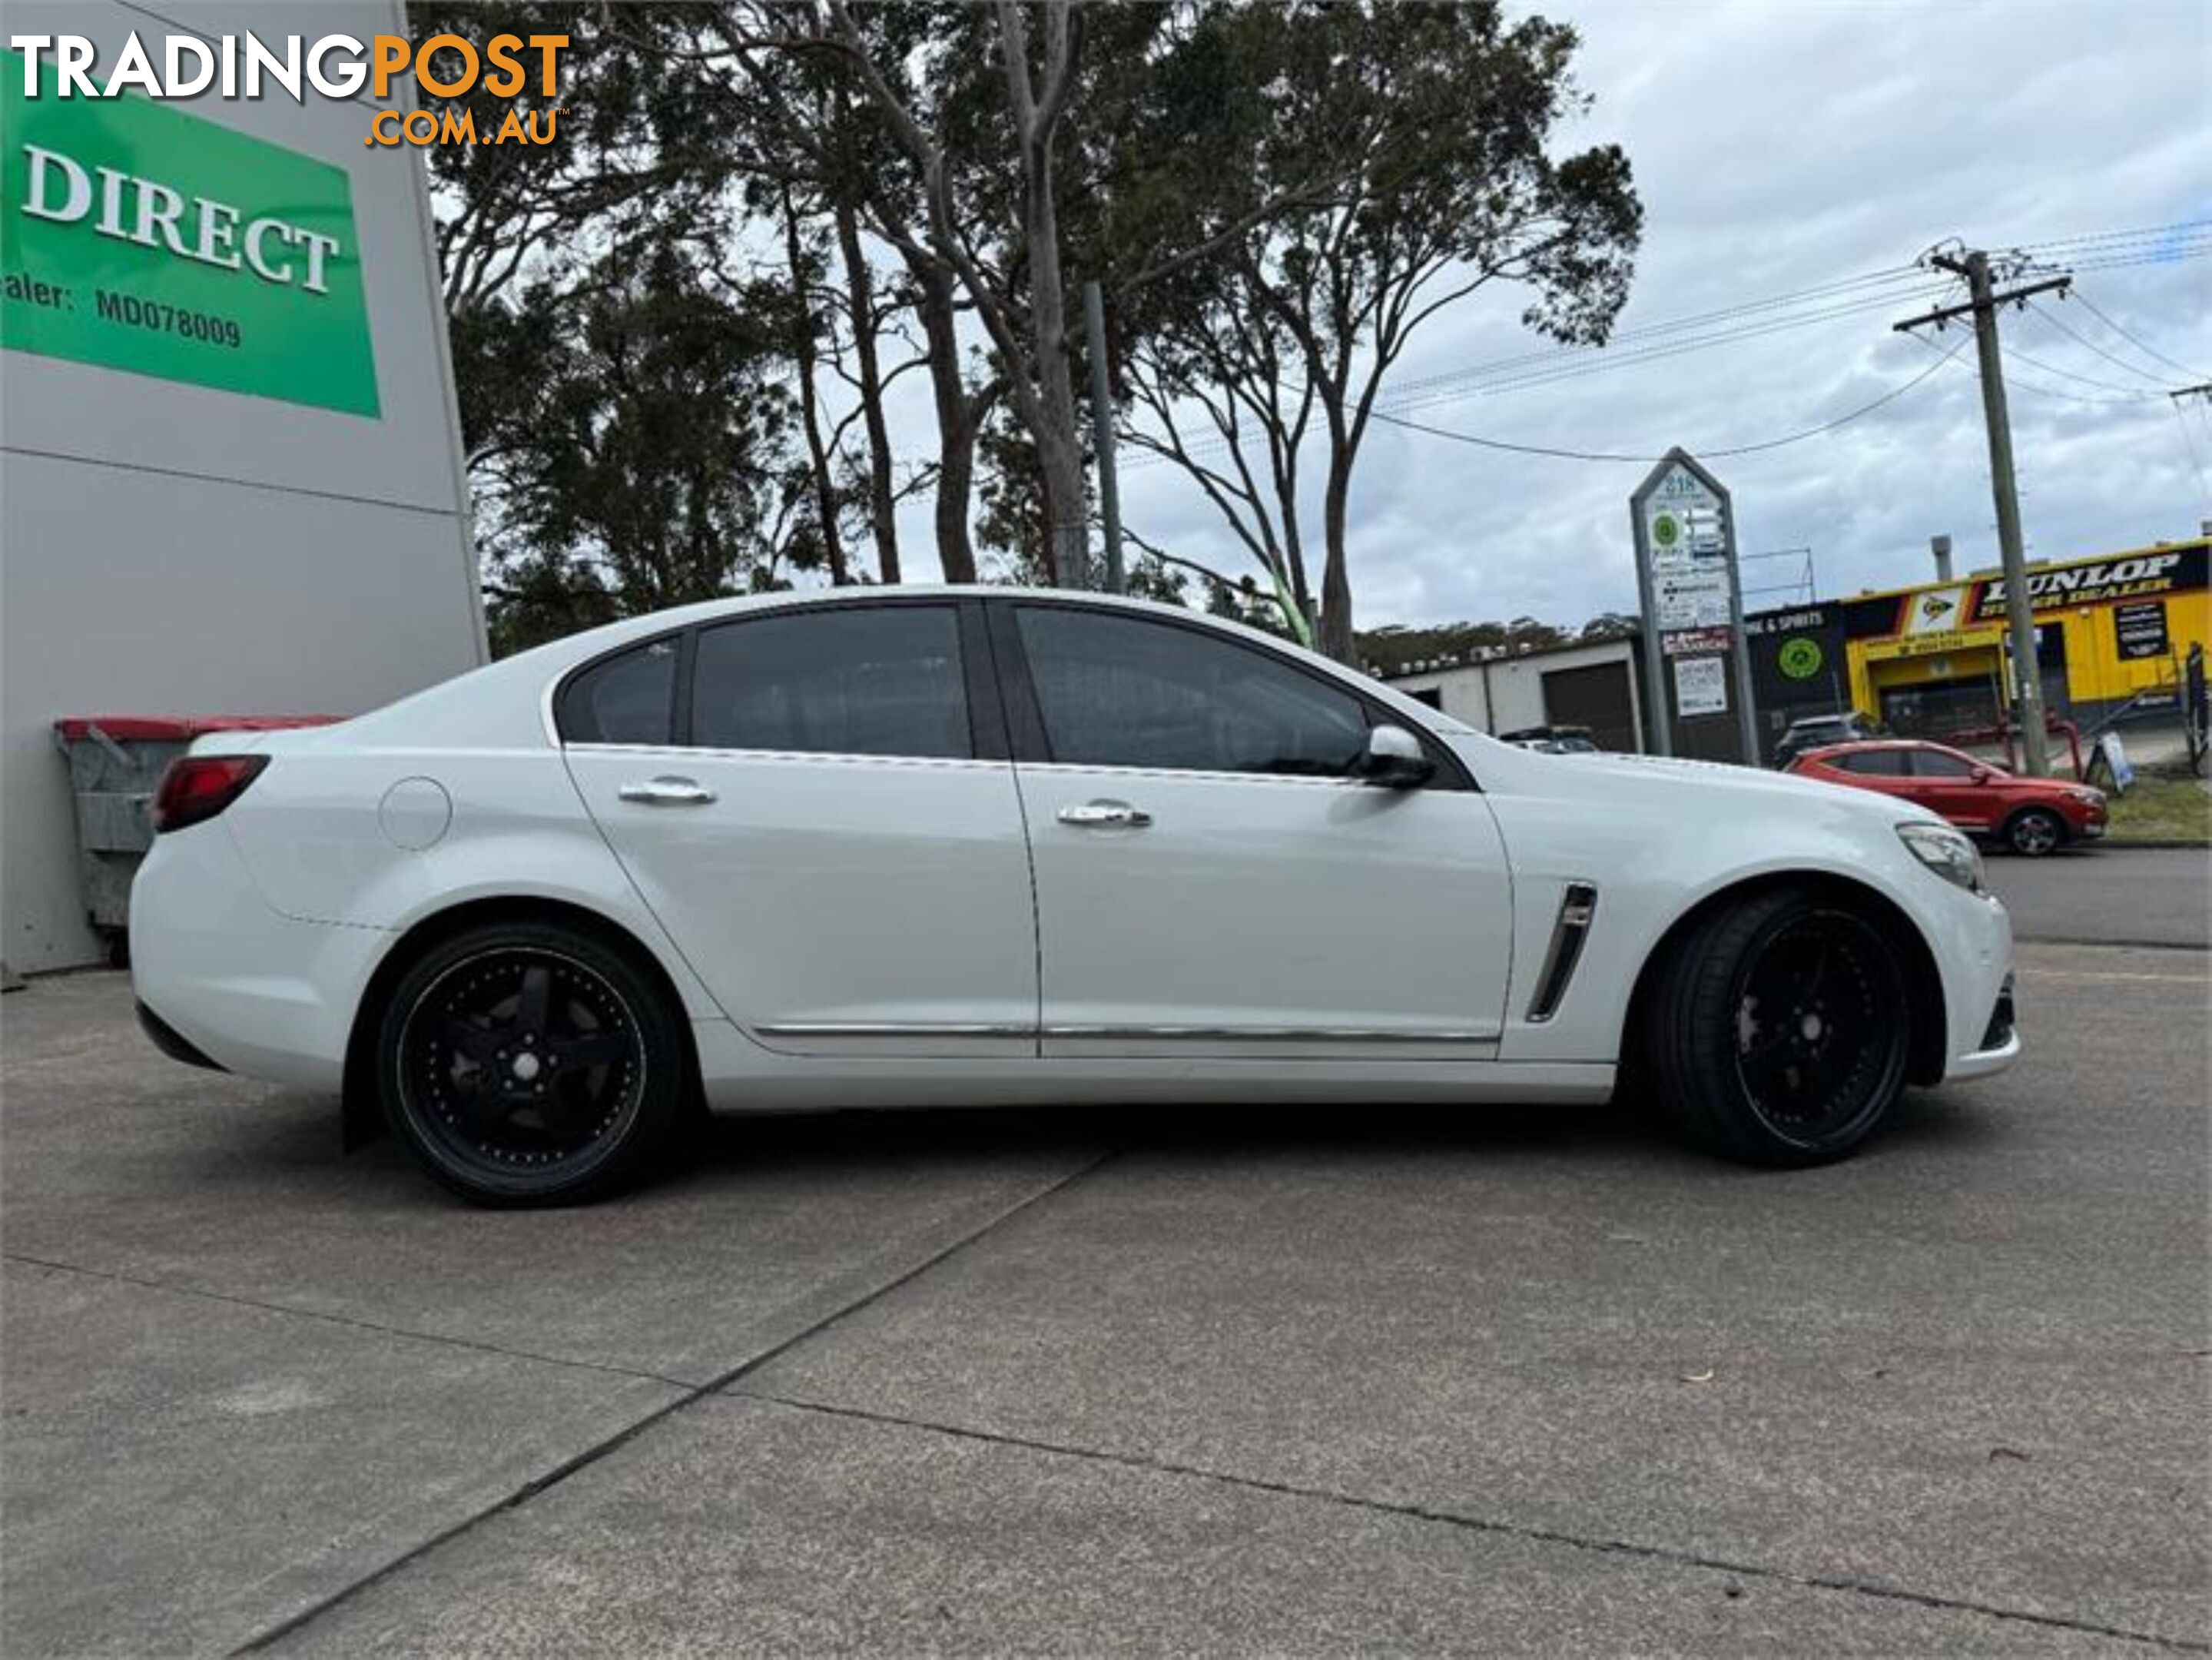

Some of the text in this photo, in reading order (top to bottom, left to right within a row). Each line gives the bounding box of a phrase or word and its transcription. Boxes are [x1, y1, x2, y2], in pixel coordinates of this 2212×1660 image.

[21, 144, 340, 294] DIRECT
[0, 272, 241, 348] aler: MD078009
[2068, 579, 2174, 603] DEALER
